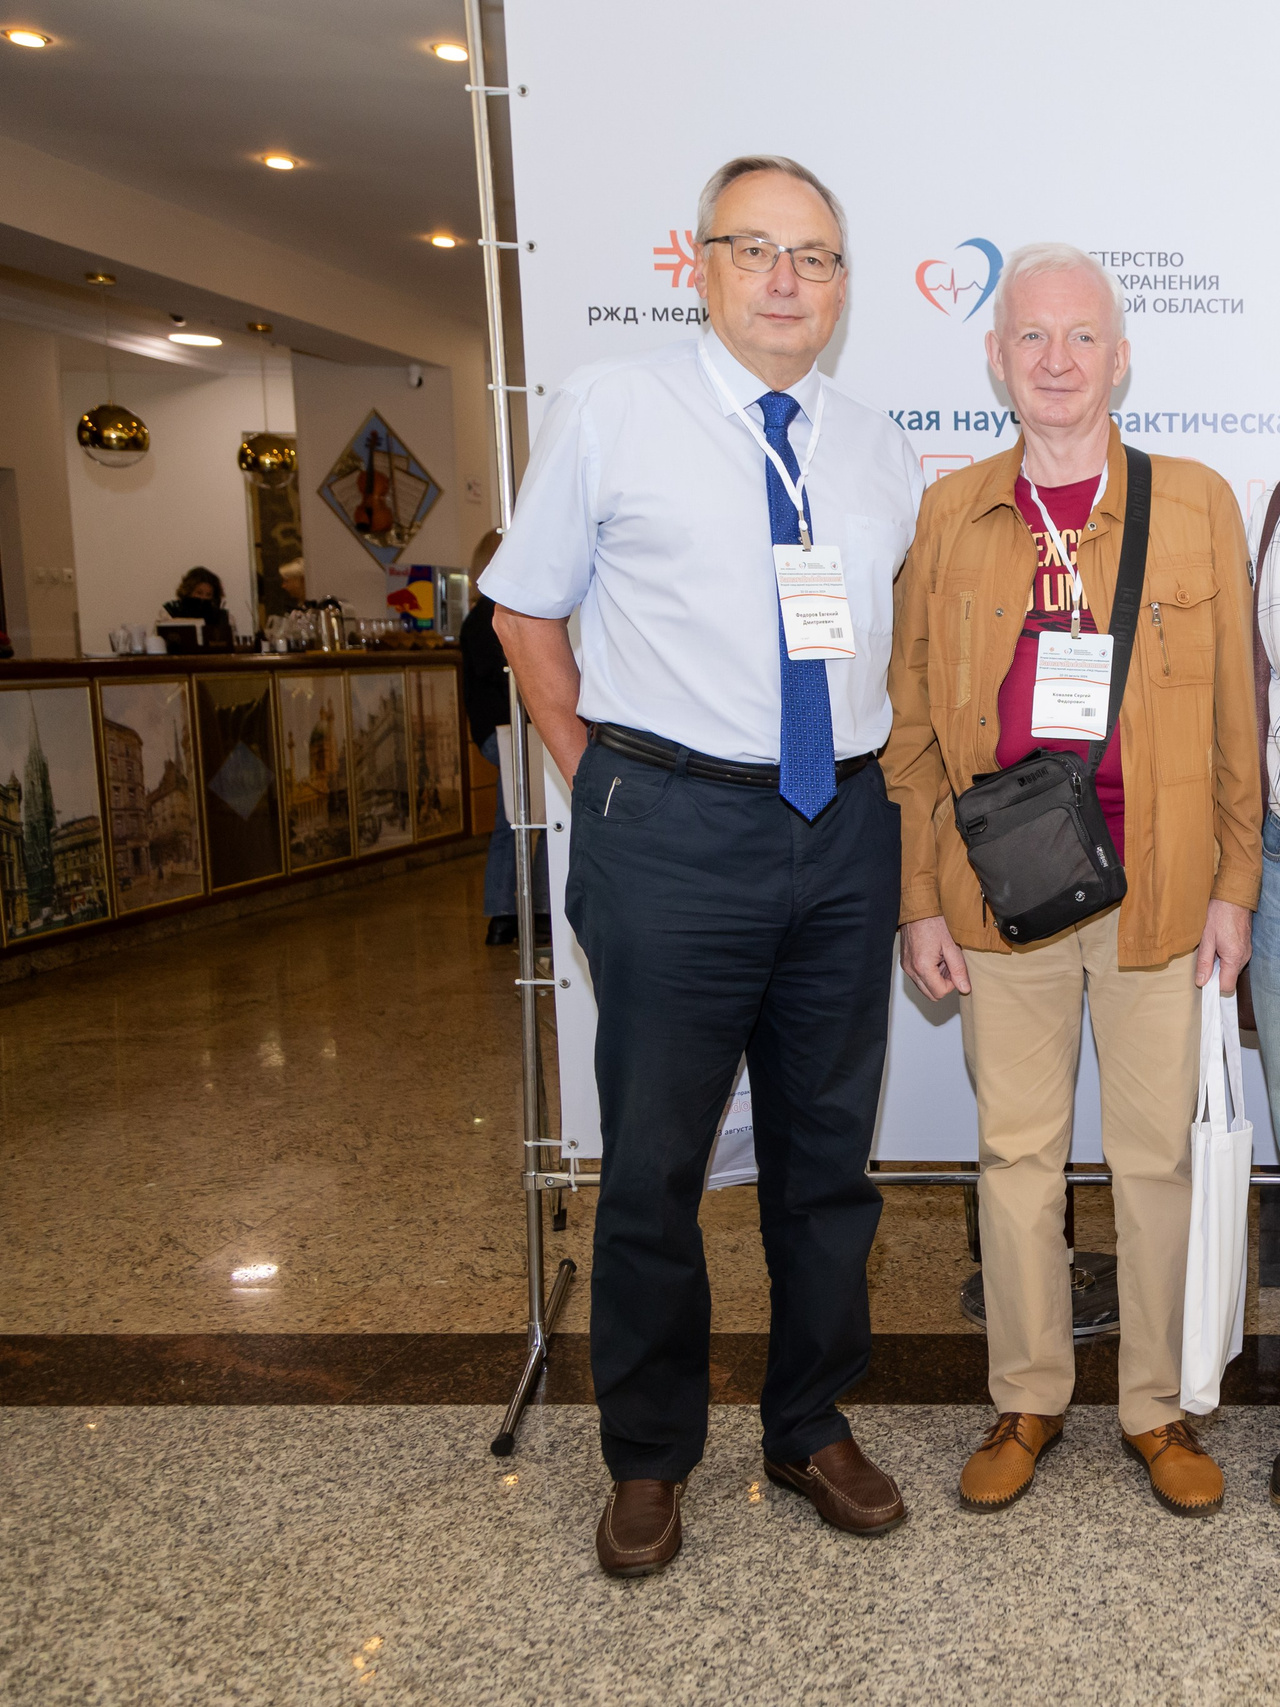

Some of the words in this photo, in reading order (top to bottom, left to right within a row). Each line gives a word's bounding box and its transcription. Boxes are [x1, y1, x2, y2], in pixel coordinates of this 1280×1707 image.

[1153, 298, 1244, 314] ОБЛАСТИ
[887, 409, 940, 431] кая
[1032, 529, 1082, 567] EXC
